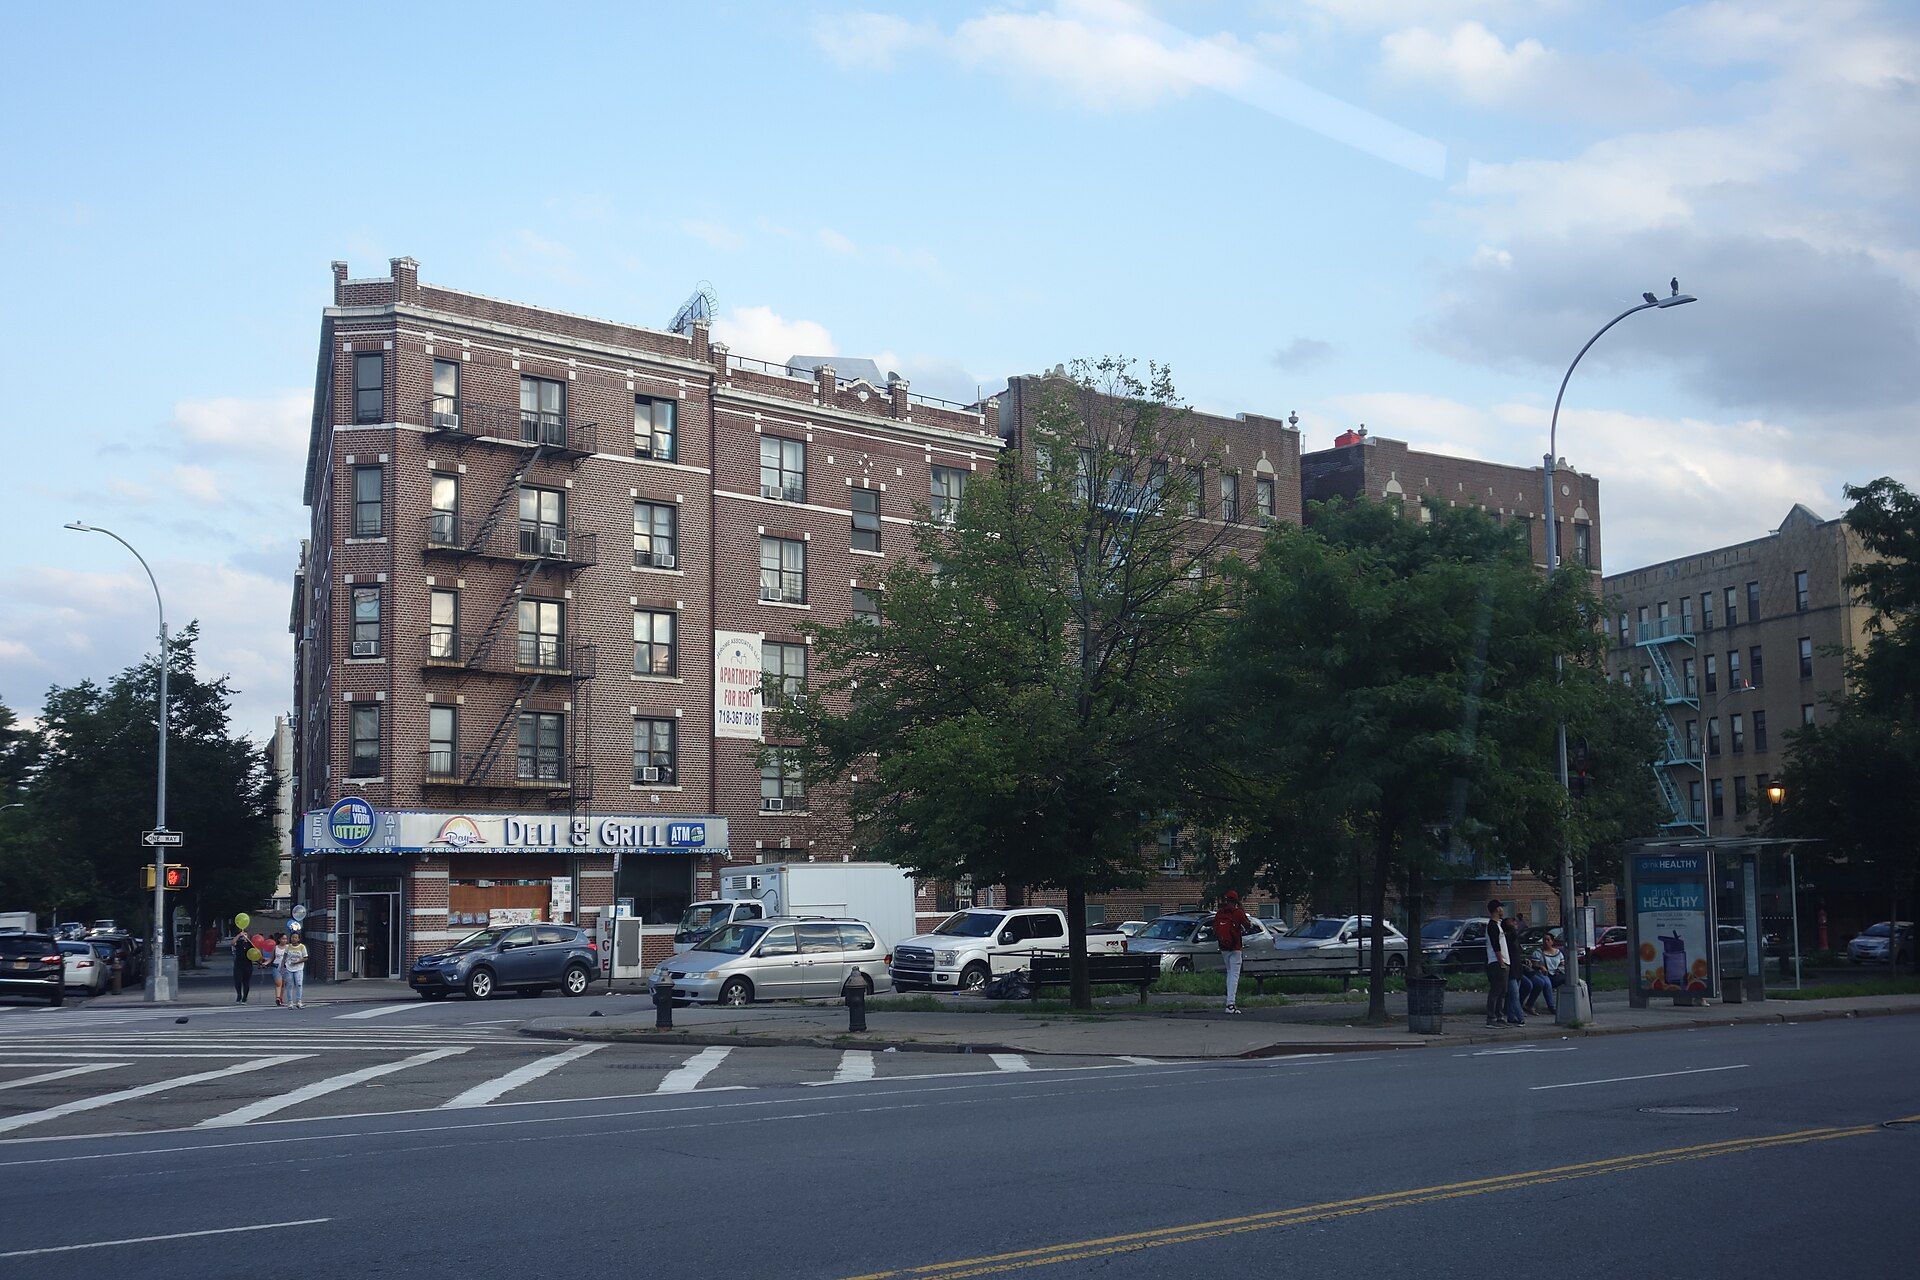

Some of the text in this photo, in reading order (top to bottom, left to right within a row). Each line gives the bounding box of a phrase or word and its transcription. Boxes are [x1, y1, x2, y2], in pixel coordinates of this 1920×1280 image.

[719, 667, 760, 687] APARTMENTS
[724, 689, 754, 708] FOR RENT
[352, 804, 367, 814] NEW
[353, 813, 370, 824] YORK
[313, 816, 323, 847] EBT
[332, 825, 371, 840] LOTTERY
[384, 815, 396, 846] ATM
[506, 818, 559, 846] DELI
[572, 820, 590, 846] &
[601, 819, 666, 847] GRILL
[671, 826, 690, 842] ATM
[446, 831, 478, 847] Ray's
[1643, 896, 1699, 908] HEALTHY
